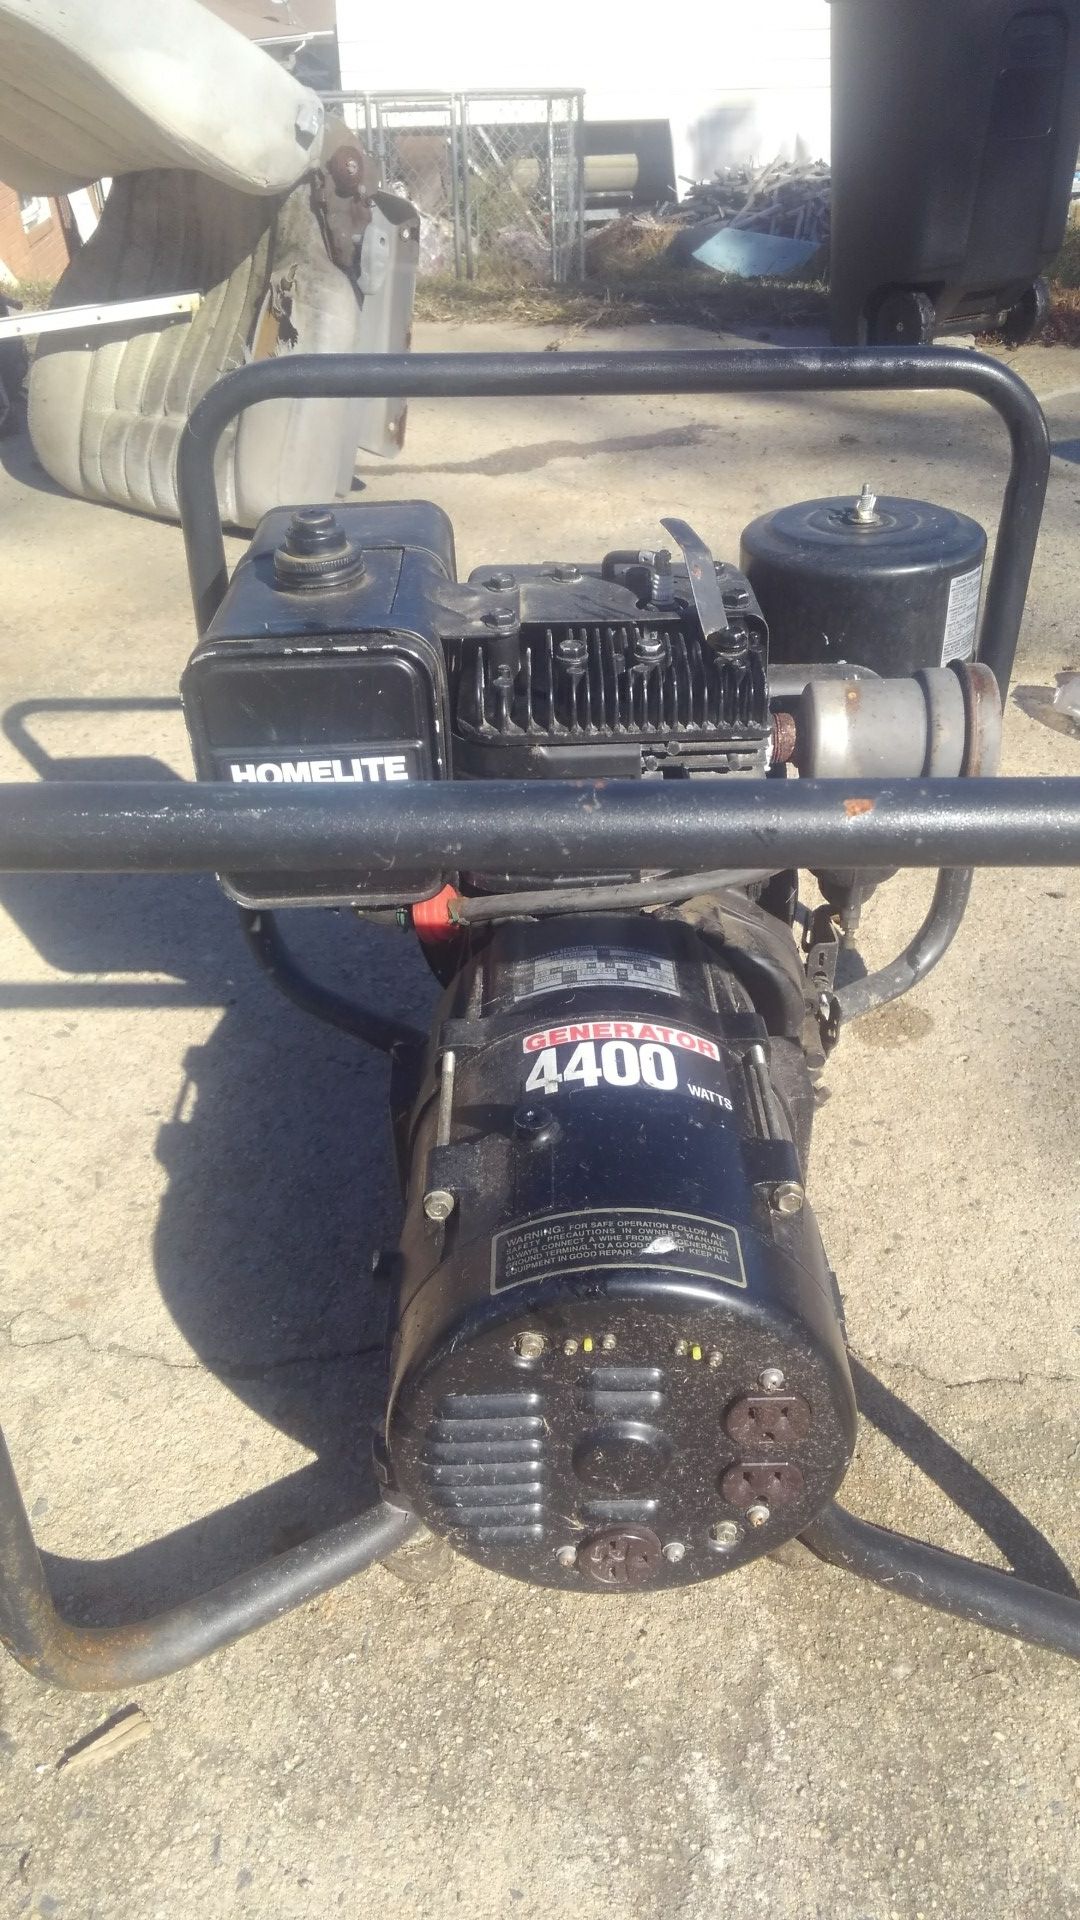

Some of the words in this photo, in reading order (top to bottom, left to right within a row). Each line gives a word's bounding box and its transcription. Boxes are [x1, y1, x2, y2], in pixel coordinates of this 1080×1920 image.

[230, 755, 409, 782] HOMELITE
[525, 1022, 716, 1059] GENERATOR
[525, 1040, 679, 1095] 4400
[687, 1083, 733, 1111] WATTS
[506, 1226, 565, 1248] WARNING:
[569, 1222, 588, 1231] FOR
[590, 1220, 613, 1228] SAFE
[617, 1220, 669, 1229] OPERATION
[671, 1223, 708, 1237] FOLLOW
[710, 1232, 727, 1243] ALL
[506, 1238, 541, 1255] SAFETY
[547, 1227, 616, 1242] PRECAUTIONS
[505, 1253, 543, 1270] GROUND
[545, 1244, 591, 1257] TERMINAL
[689, 1246, 713, 1257] KEEP
[714, 1253, 731, 1264] ALL
[505, 1257, 556, 1278] EQUIPMENT
[558, 1254, 567, 1263] IN
[569, 1250, 597, 1260] GOOD
[599, 1248, 635, 1257] REPAIR.
[506, 1248, 539, 1264] ALWAYS
[541, 1237, 585, 1251] CONNECT
[599, 1234, 622, 1242] WIRE
[677, 1238, 730, 1257] GENERATOR
